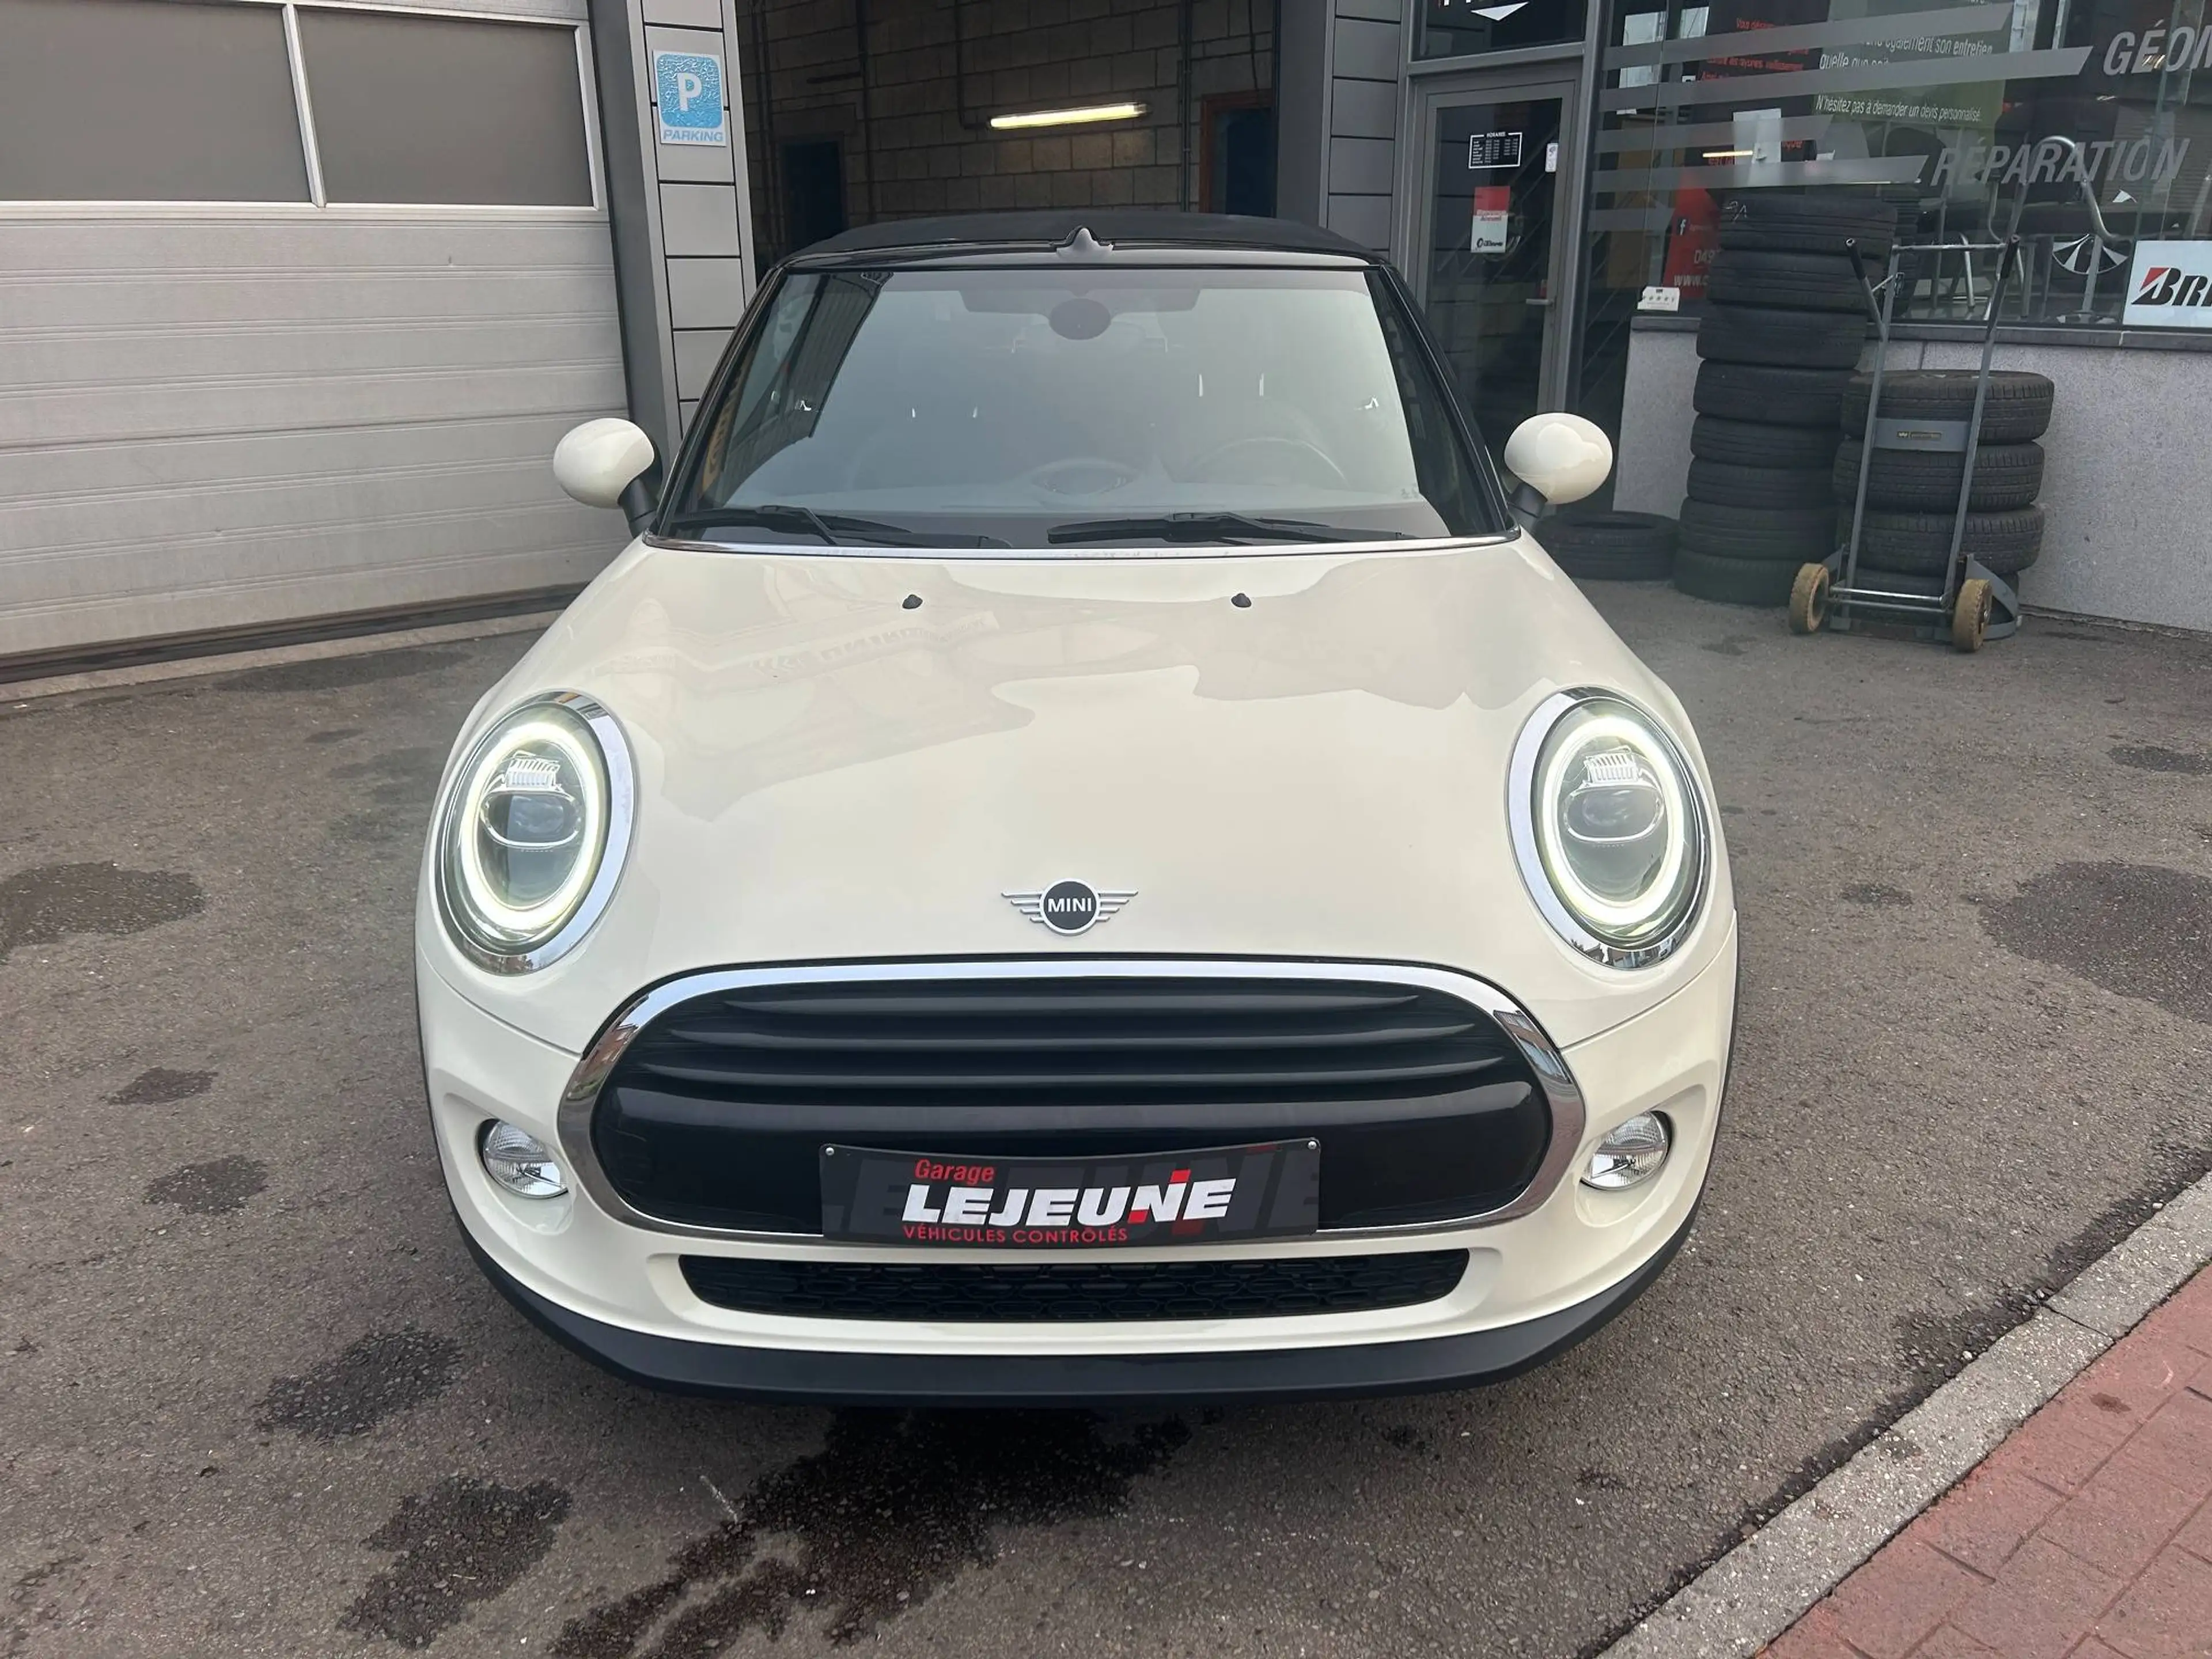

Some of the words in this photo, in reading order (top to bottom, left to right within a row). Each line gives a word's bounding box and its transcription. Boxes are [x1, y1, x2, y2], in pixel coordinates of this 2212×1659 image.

[1935, 38, 1952, 54] son
[1953, 39, 1993, 56] entretien
[677, 73, 702, 112] P
[1816, 94, 1851, 113] N'hésitez
[1851, 99, 1865, 115] pas
[1873, 100, 1908, 118] demander
[1908, 105, 1919, 117] un
[1921, 103, 1938, 120] devis
[663, 129, 724, 142] PARKING
[1930, 136, 2191, 187] RÉPARATION
[1048, 897, 1092, 912] MINI
[915, 1159, 995, 1185] Garage
[902, 1169, 1237, 1227] LEJEUNE
[902, 1222, 1006, 1243] VÉHICULES
[1013, 1225, 1128, 1244] CONTRÔLÉS
